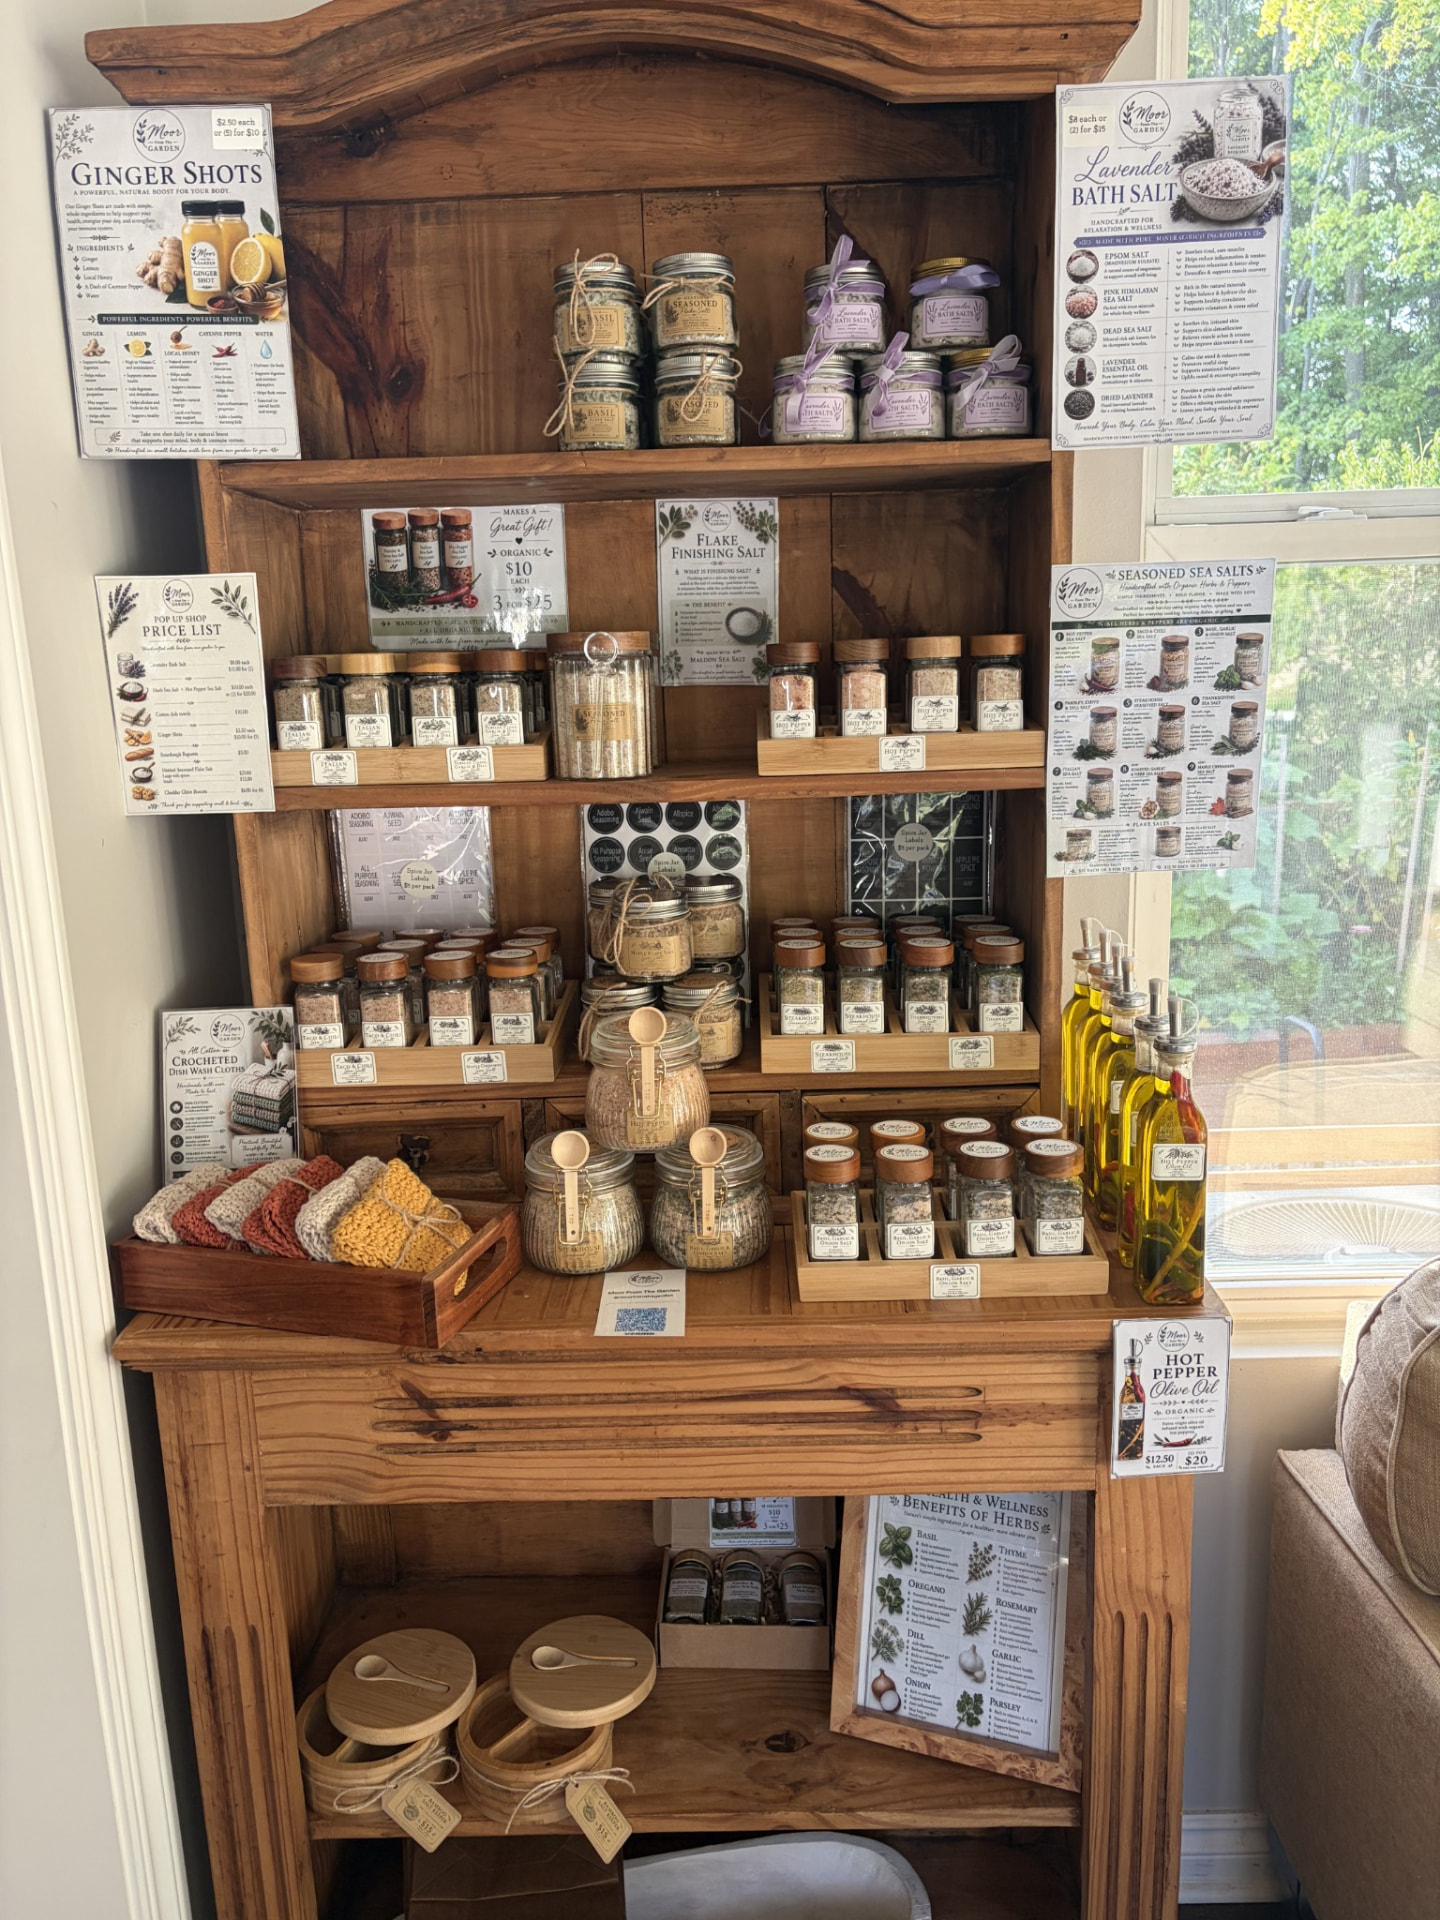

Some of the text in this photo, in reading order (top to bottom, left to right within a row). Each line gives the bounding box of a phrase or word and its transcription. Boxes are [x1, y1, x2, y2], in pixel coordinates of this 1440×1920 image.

[1068, 115, 1078, 124] $8
[1079, 114, 1096, 122] each
[1134, 105, 1168, 121] Moor
[217, 118, 237, 126] $2.50
[147, 123, 182, 137] Moor
[233, 128, 244, 136] for
[246, 128, 260, 137] $10
[1069, 124, 1106, 134] (2) for $15
[1133, 126, 1165, 134] GARDEN
[1074, 146, 1174, 184] Lavender
[71, 161, 262, 186] GINGER SHOTS
[1072, 182, 1178, 206] BATH SALT
[1123, 287, 1158, 295] HIMALAYAN
[673, 300, 717, 308] SEASONED
[937, 310, 954, 318] BATH
[490, 517, 553, 537] Great Gift!
[697, 534, 738, 546] FLAKE
[500, 549, 541, 557] ORGANIC
[672, 546, 766, 559] FINISHING SALT
[506, 561, 533, 575] $10
[1118, 565, 1253, 580] SEASONED SEA SALTS
[1068, 582, 1101, 598] Moor
[1119, 582, 1157, 592] Handcrafted
[1200, 580, 1216, 588] Herbs
[1226, 579, 1250, 590] Peppers
[493, 595, 503, 611] 3
[525, 595, 553, 610] $25
[155, 615, 169, 623] POP
[142, 624, 222, 637] PRICE LIST
[172, 1056, 238, 1067] CROCHETED
[190, 1067, 213, 1075] WASH
[1167, 1330, 1187, 1339] Moor
[1166, 1354, 1204, 1365] HOT
[1153, 1367, 1218, 1379] PEPPER
[1150, 1379, 1220, 1398] Olive Oil
[1146, 1455, 1174, 1464] $12.50
[1185, 1456, 1208, 1465] $20
[973, 1495, 1049, 1517] & WELLNESS
[903, 1495, 1040, 1532] BENEFITS OF HERBS
[917, 1530, 938, 1541] BASIL
[999, 1546, 1028, 1559] THYME
[908, 1579, 946, 1594] OREGANO
[995, 1597, 1038, 1614] ROSEMARY
[907, 1629, 925, 1641] DILL
[992, 1649, 1021, 1663] GARLIC
[905, 1677, 931, 1690] ONION
[990, 1697, 1021, 1712] PARSLEY
[420, 1820, 433, 1833] $15
